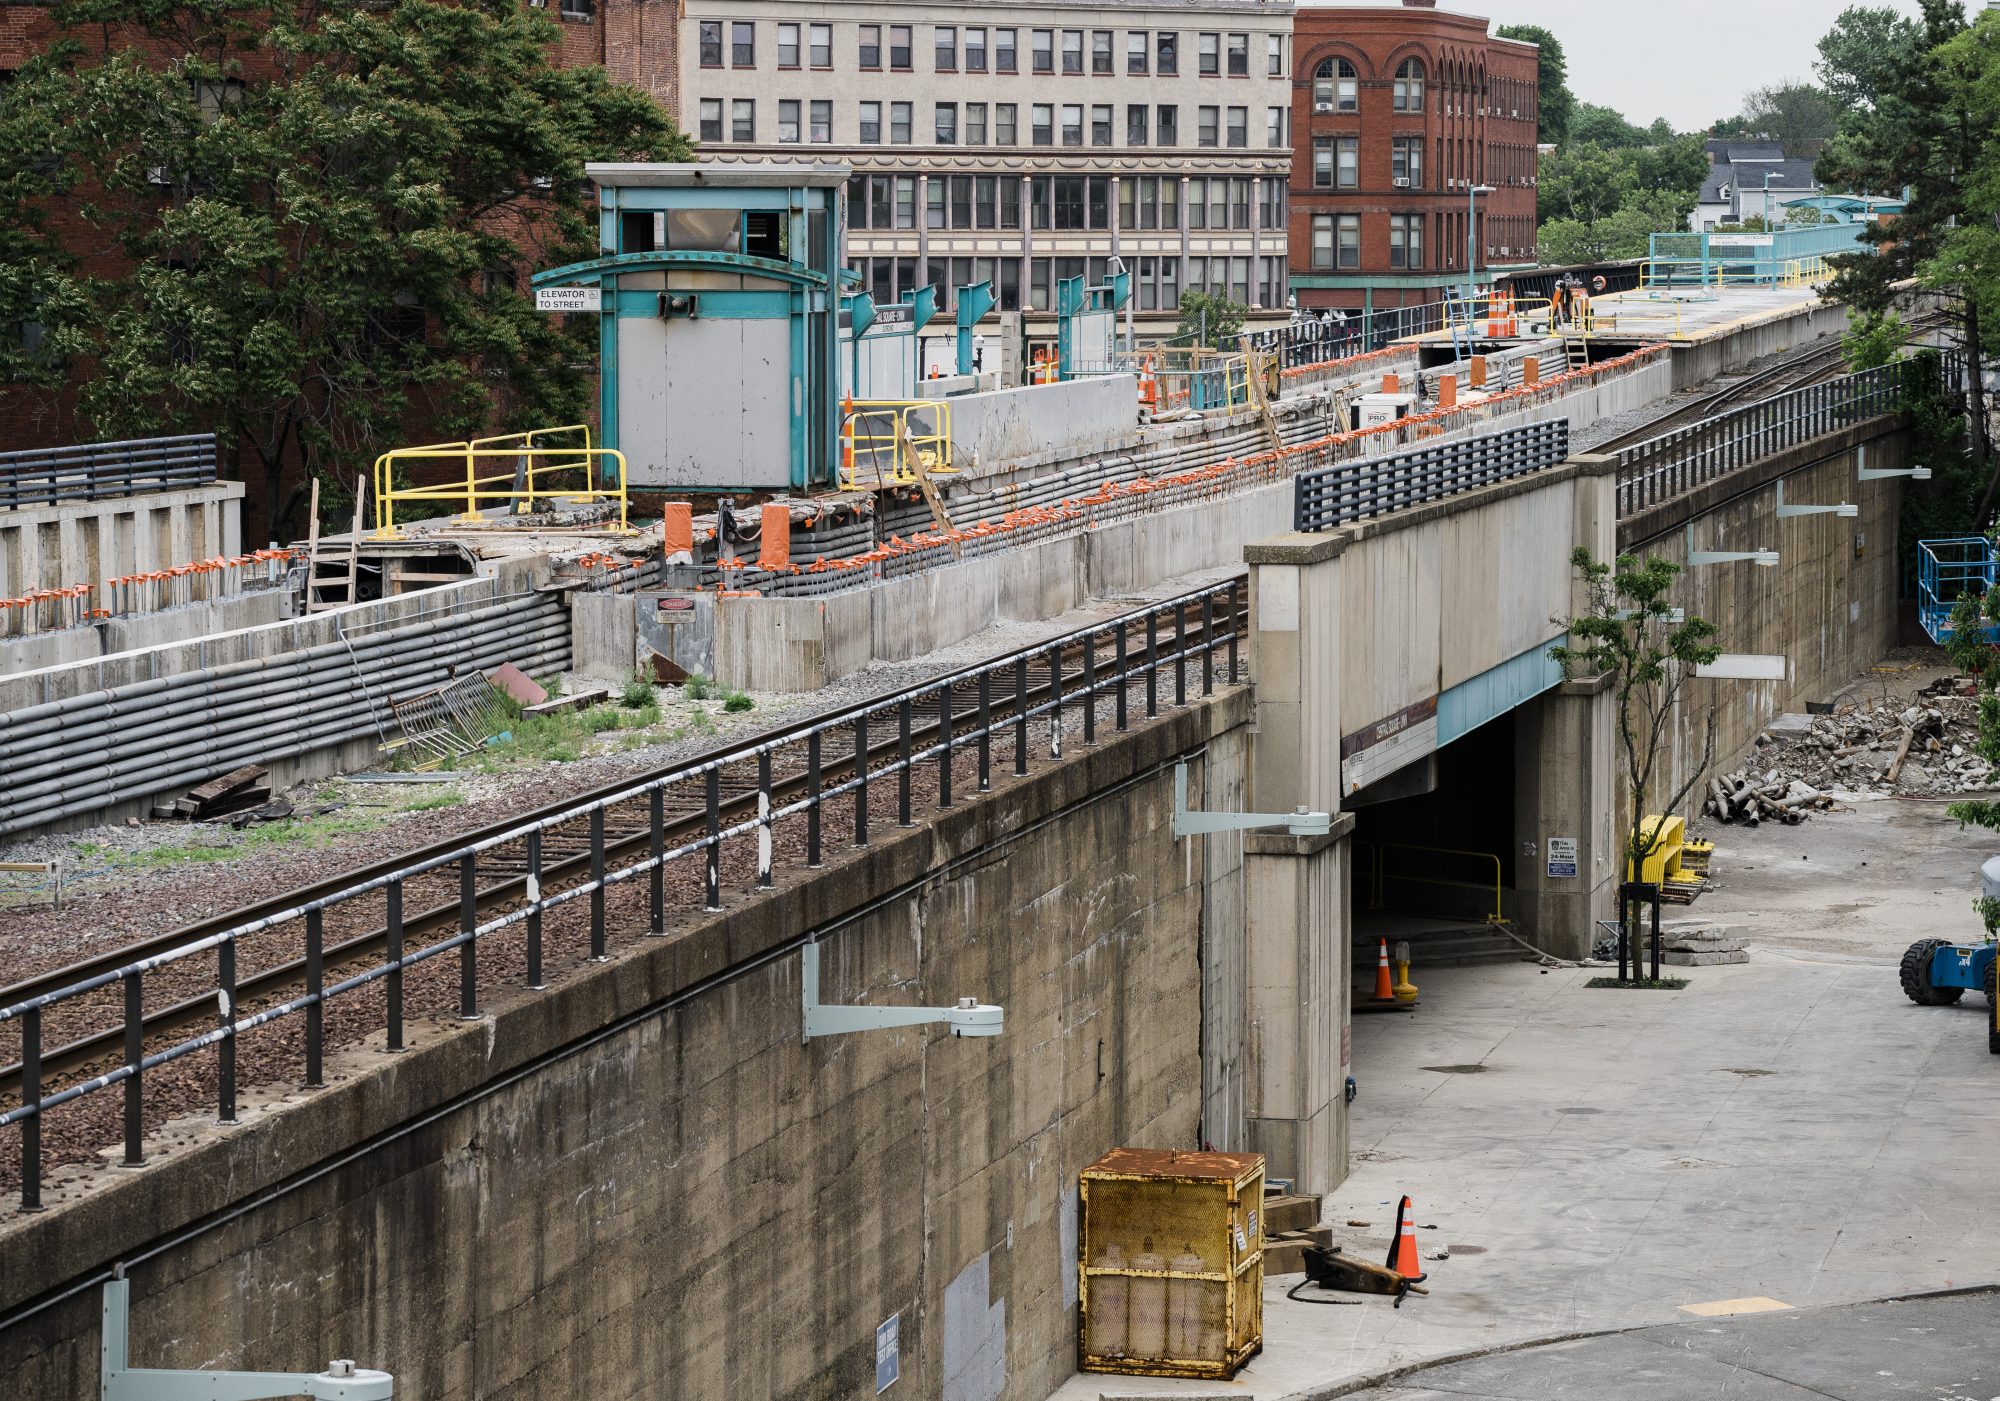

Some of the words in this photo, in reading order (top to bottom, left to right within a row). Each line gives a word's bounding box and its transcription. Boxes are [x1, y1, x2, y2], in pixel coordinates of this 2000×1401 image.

[541, 290, 585, 298] ELEVATOR
[540, 300, 551, 308] TO
[553, 300, 584, 308] STREET
